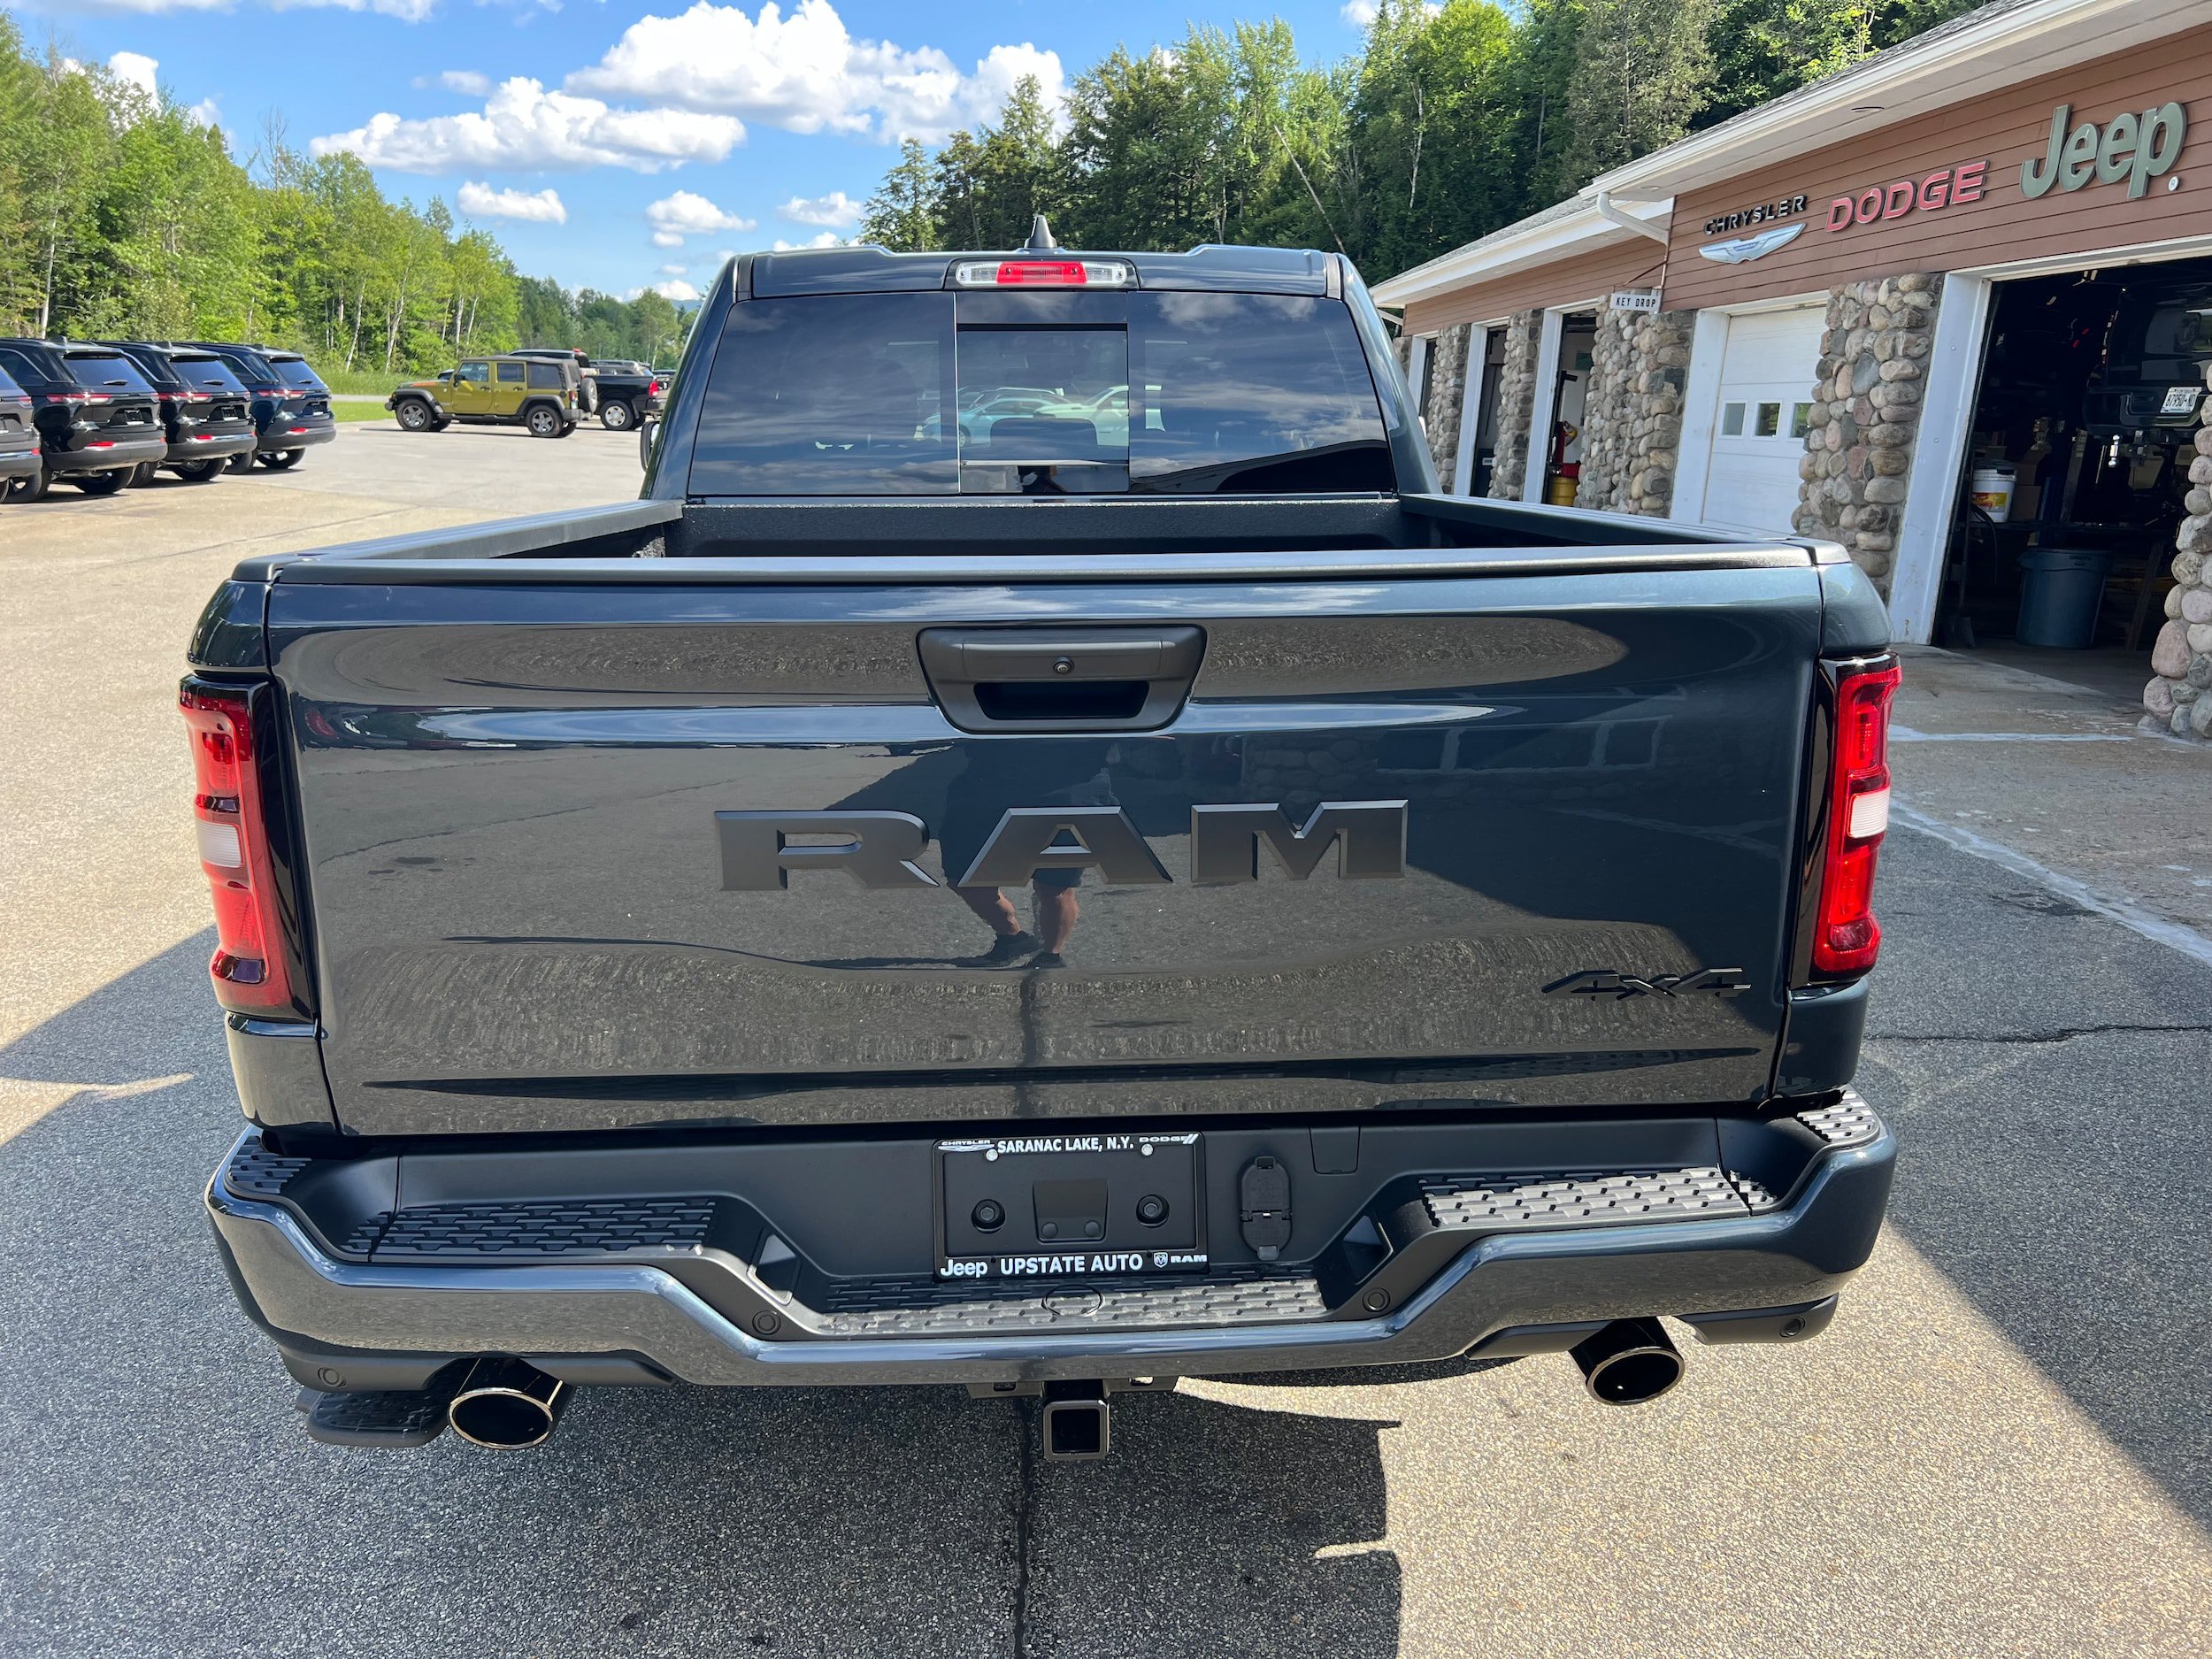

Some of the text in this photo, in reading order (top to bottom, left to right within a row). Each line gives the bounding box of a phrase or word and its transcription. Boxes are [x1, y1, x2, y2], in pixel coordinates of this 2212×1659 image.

[2020, 102, 2187, 199] Jeep
[1825, 160, 1991, 232] DODGE
[1704, 195, 1808, 236] CHRYSLER
[1616, 296, 1656, 308] KEY DROP
[714, 800, 1409, 890] RAM
[997, 1136, 1134, 1154] SARANAC LAKE, N.Y.
[940, 1259, 988, 1279] Jeep
[1000, 1254, 1143, 1275] UPSTATE AUTO
[1170, 1254, 1208, 1263] RAM
